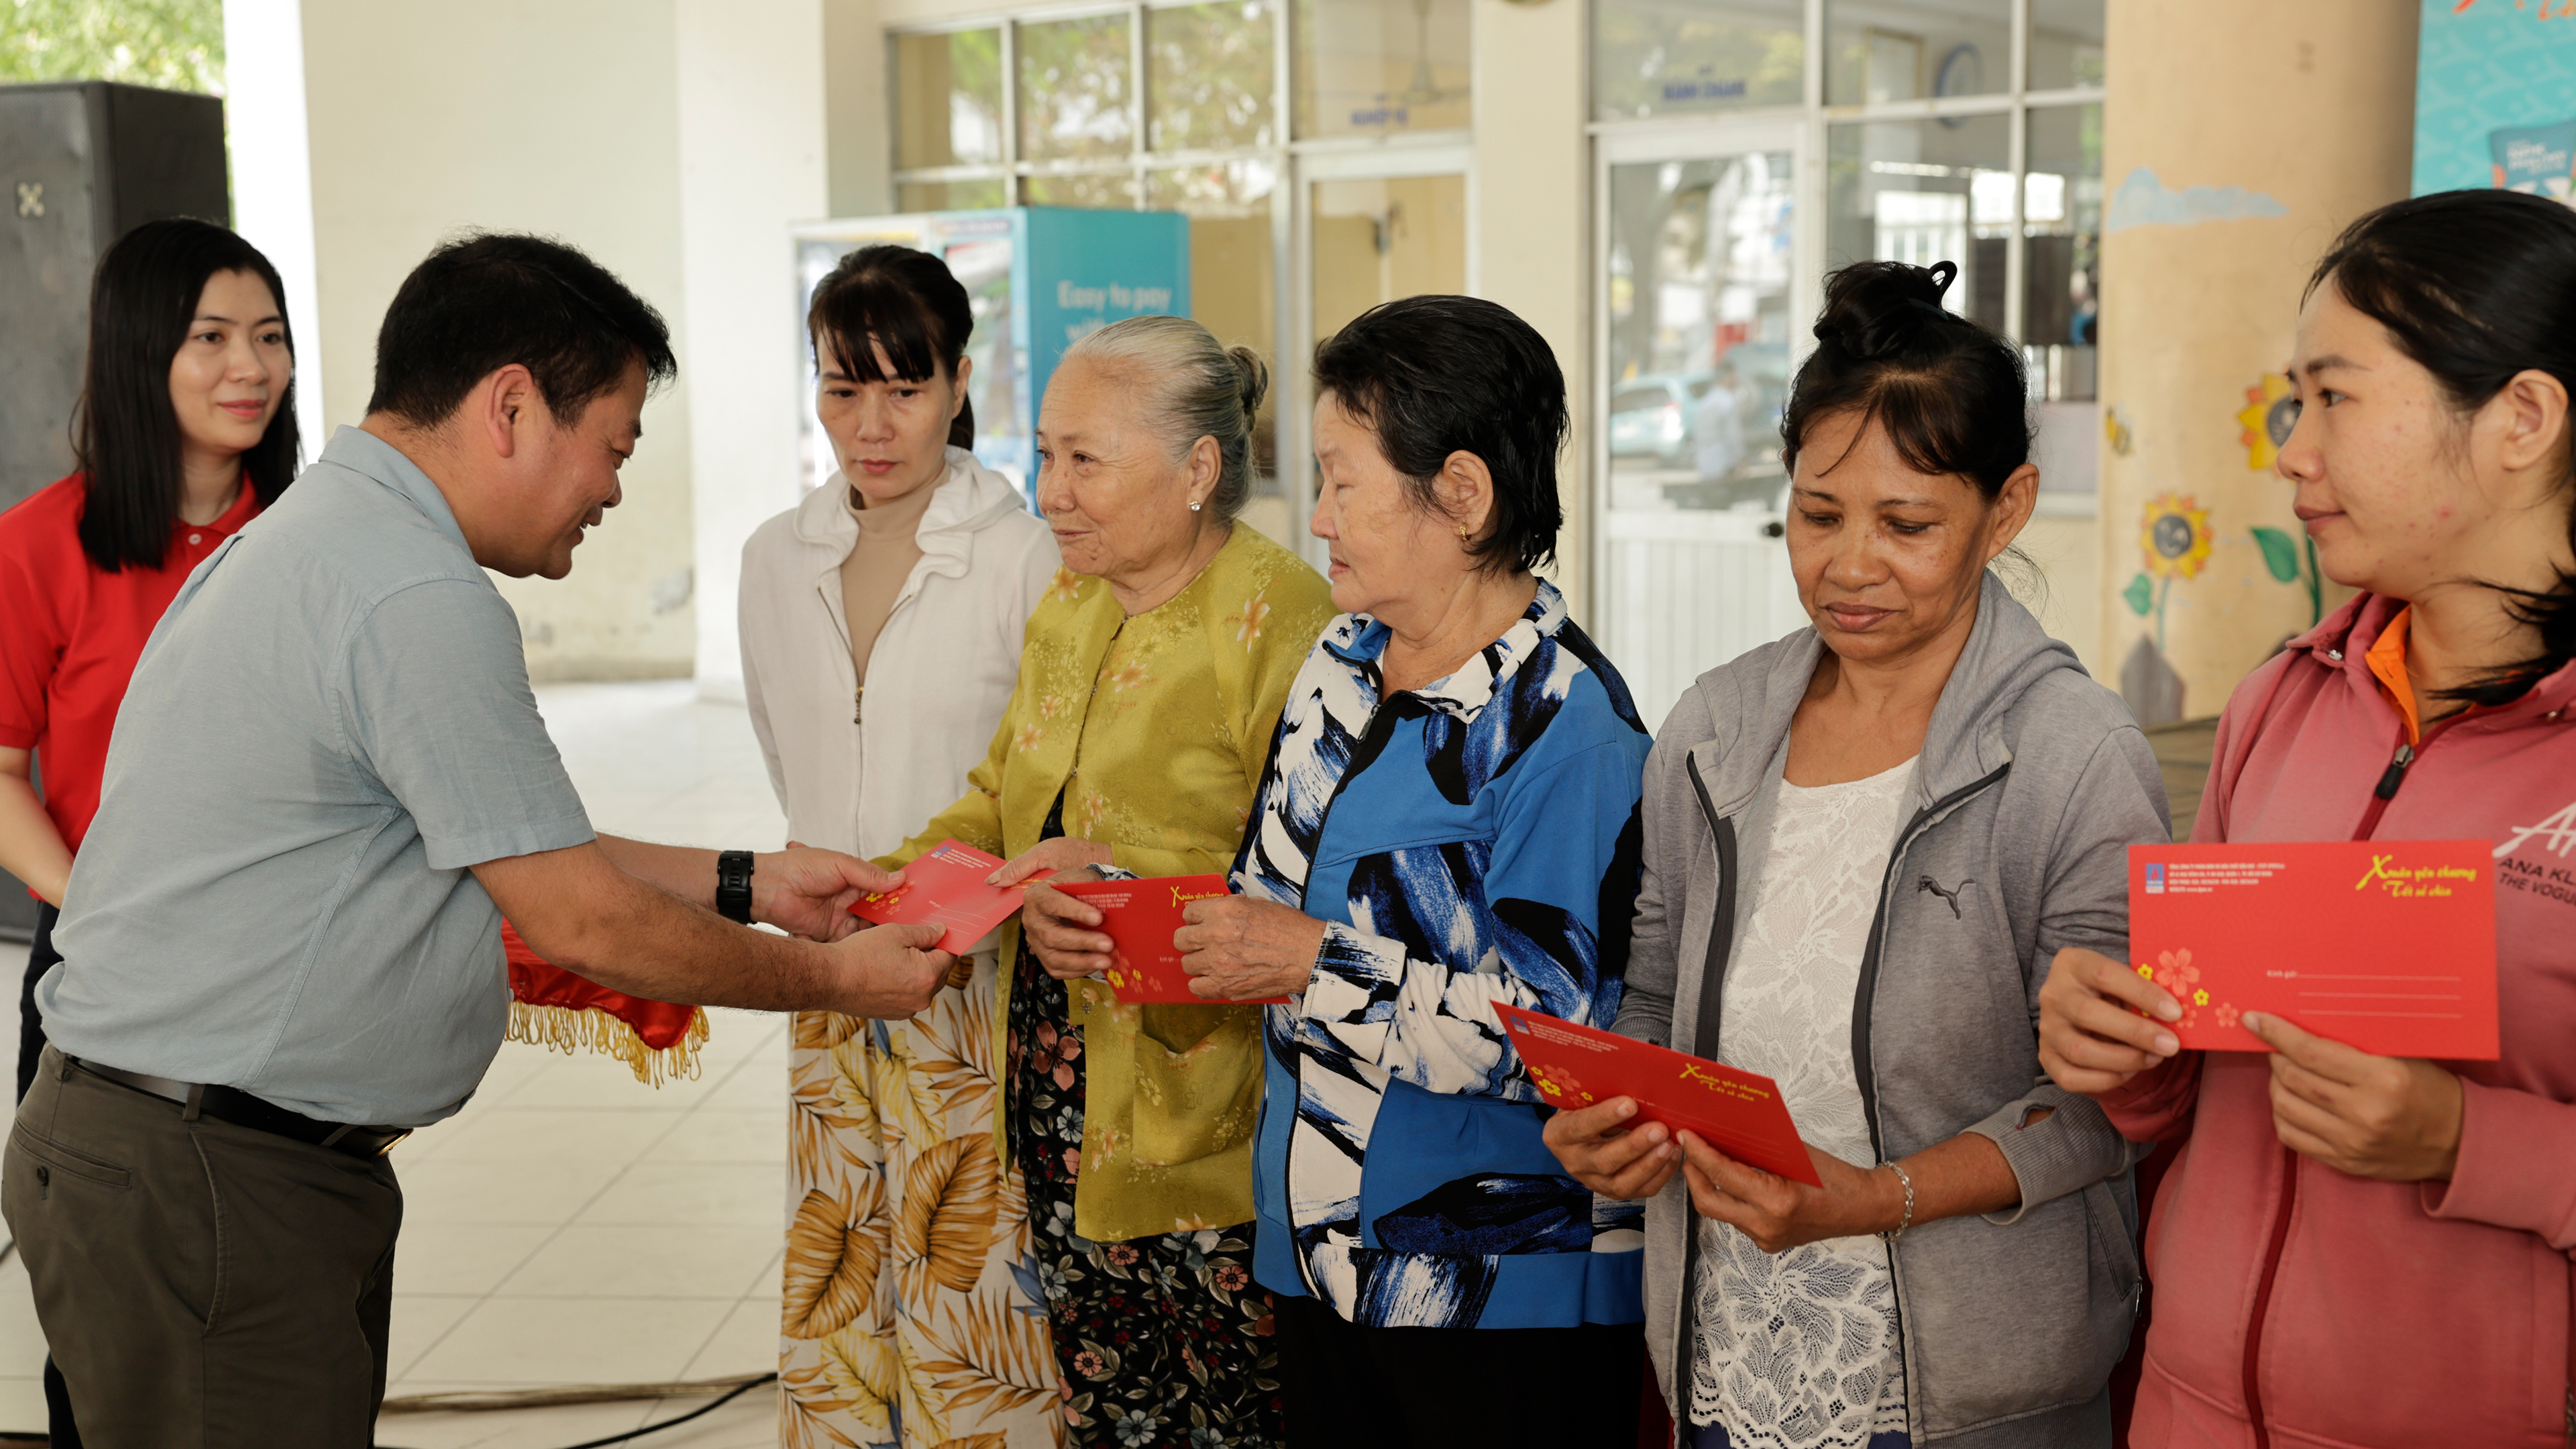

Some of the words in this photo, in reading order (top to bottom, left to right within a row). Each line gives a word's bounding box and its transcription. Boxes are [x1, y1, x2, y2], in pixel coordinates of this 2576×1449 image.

[1057, 280, 1106, 313] Easy
[1109, 280, 1132, 309] to
[1133, 286, 1172, 315] pay
[2492, 800, 2576, 858] A
[2355, 854, 2412, 891] Xuân
[2498, 858, 2543, 877] ANA
[2548, 868, 2576, 887] KL
[2500, 873, 2529, 891] THE
[2532, 881, 2576, 906] VOGU
